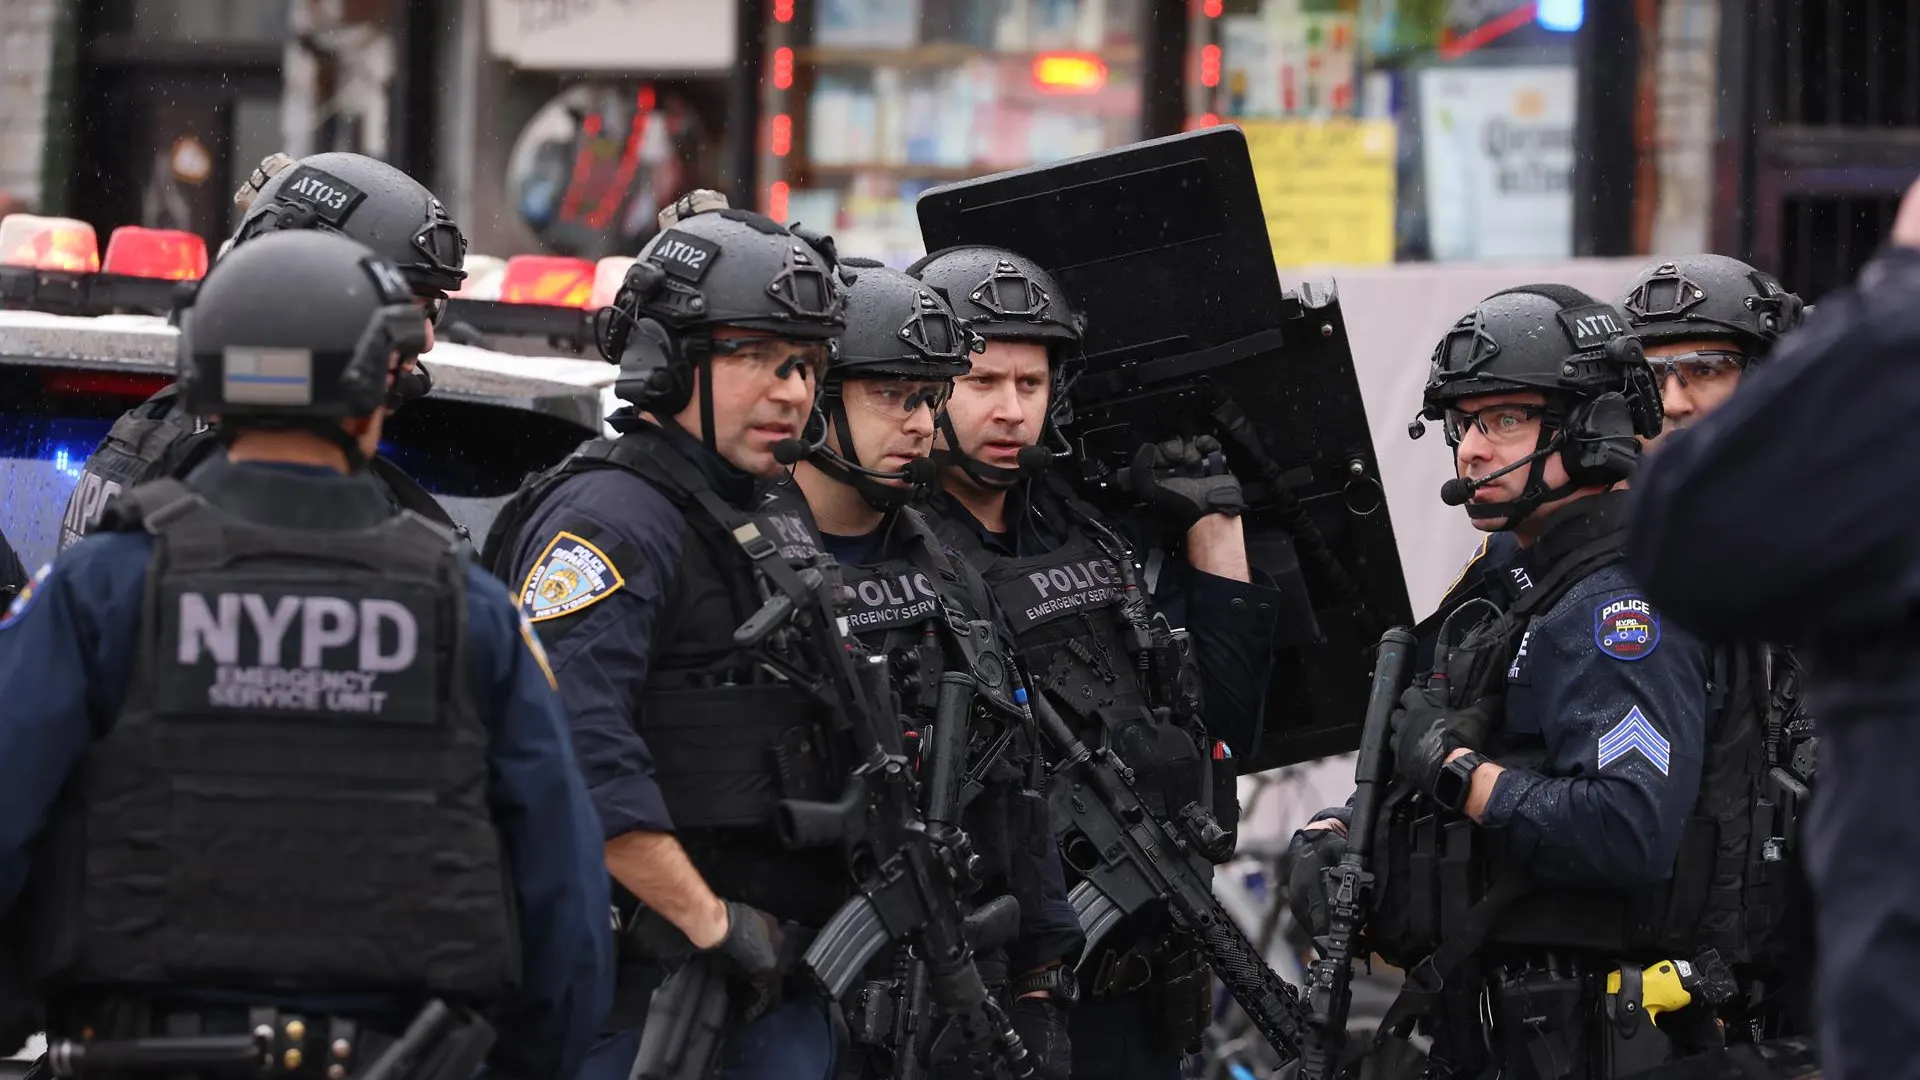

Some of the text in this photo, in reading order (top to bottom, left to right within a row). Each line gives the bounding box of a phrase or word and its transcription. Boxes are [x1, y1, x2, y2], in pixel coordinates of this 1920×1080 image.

[572, 545, 606, 574] POLICE
[843, 573, 937, 606] OLIC
[902, 600, 936, 619] SERV
[1026, 592, 1087, 620] EMERGENCY
[1603, 600, 1650, 620] POLICE
[178, 592, 418, 672] NYPD
